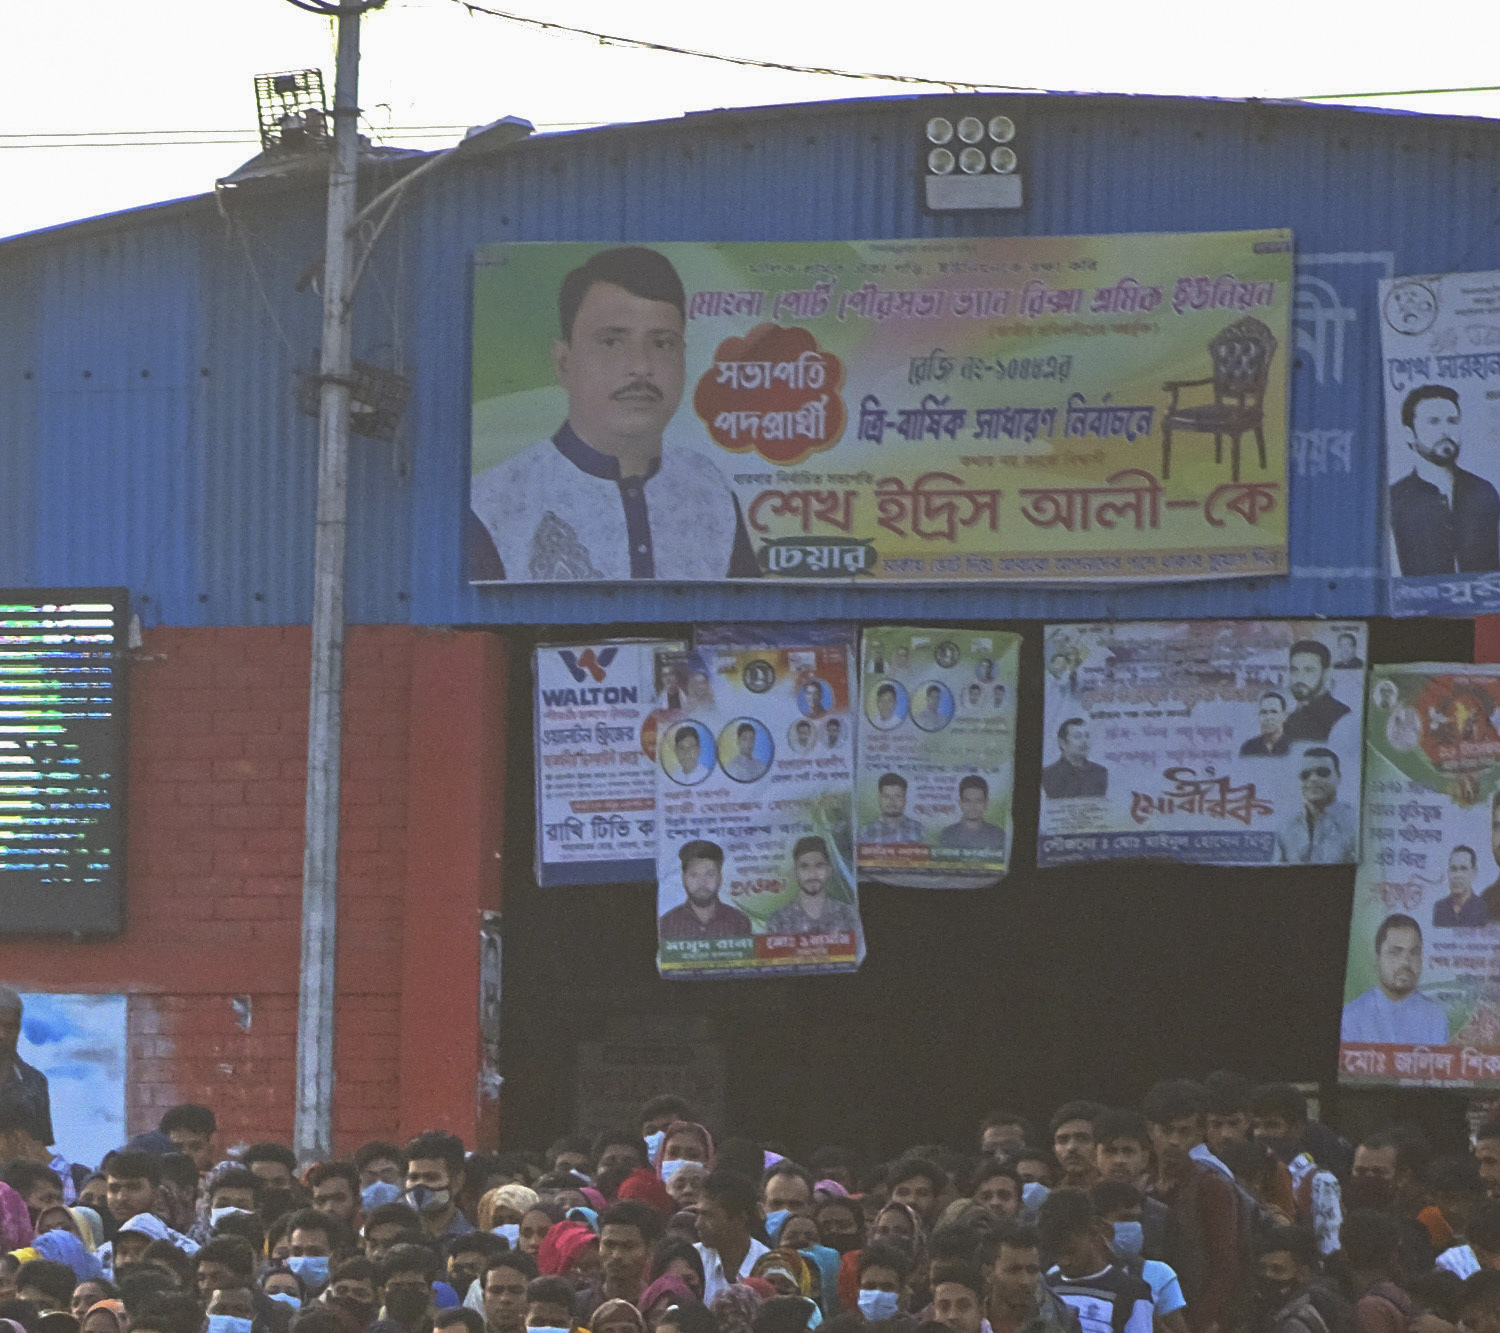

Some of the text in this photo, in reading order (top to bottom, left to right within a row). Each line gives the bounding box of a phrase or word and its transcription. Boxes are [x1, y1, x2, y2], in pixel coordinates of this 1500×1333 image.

[689, 287, 766, 321] মোংলা
[772, 278, 834, 319] পোর্ট
[838, 282, 948, 320] পৌরসভা
[953, 287, 1011, 316] ভ্যান
[1090, 278, 1164, 314] শ্রমিক
[1170, 274, 1276, 314] ইউনিয়ন
[716, 351, 827, 390] সভাপতি
[1388, 356, 1430, 391] শেখ
[713, 394, 828, 441] পদপ্রার্থী
[857, 393, 1156, 445] ত্রি-বার্ষিক সাধারণ নির্বাচনে
[748, 487, 858, 534] শেখ
[874, 470, 1002, 541] ইদ্রিস
[767, 538, 867, 574] চেয়ার
[542, 686, 638, 706] WALTON
[1343, 1050, 1387, 1073] মোঃ
[1393, 1045, 1455, 1075] জলিল
